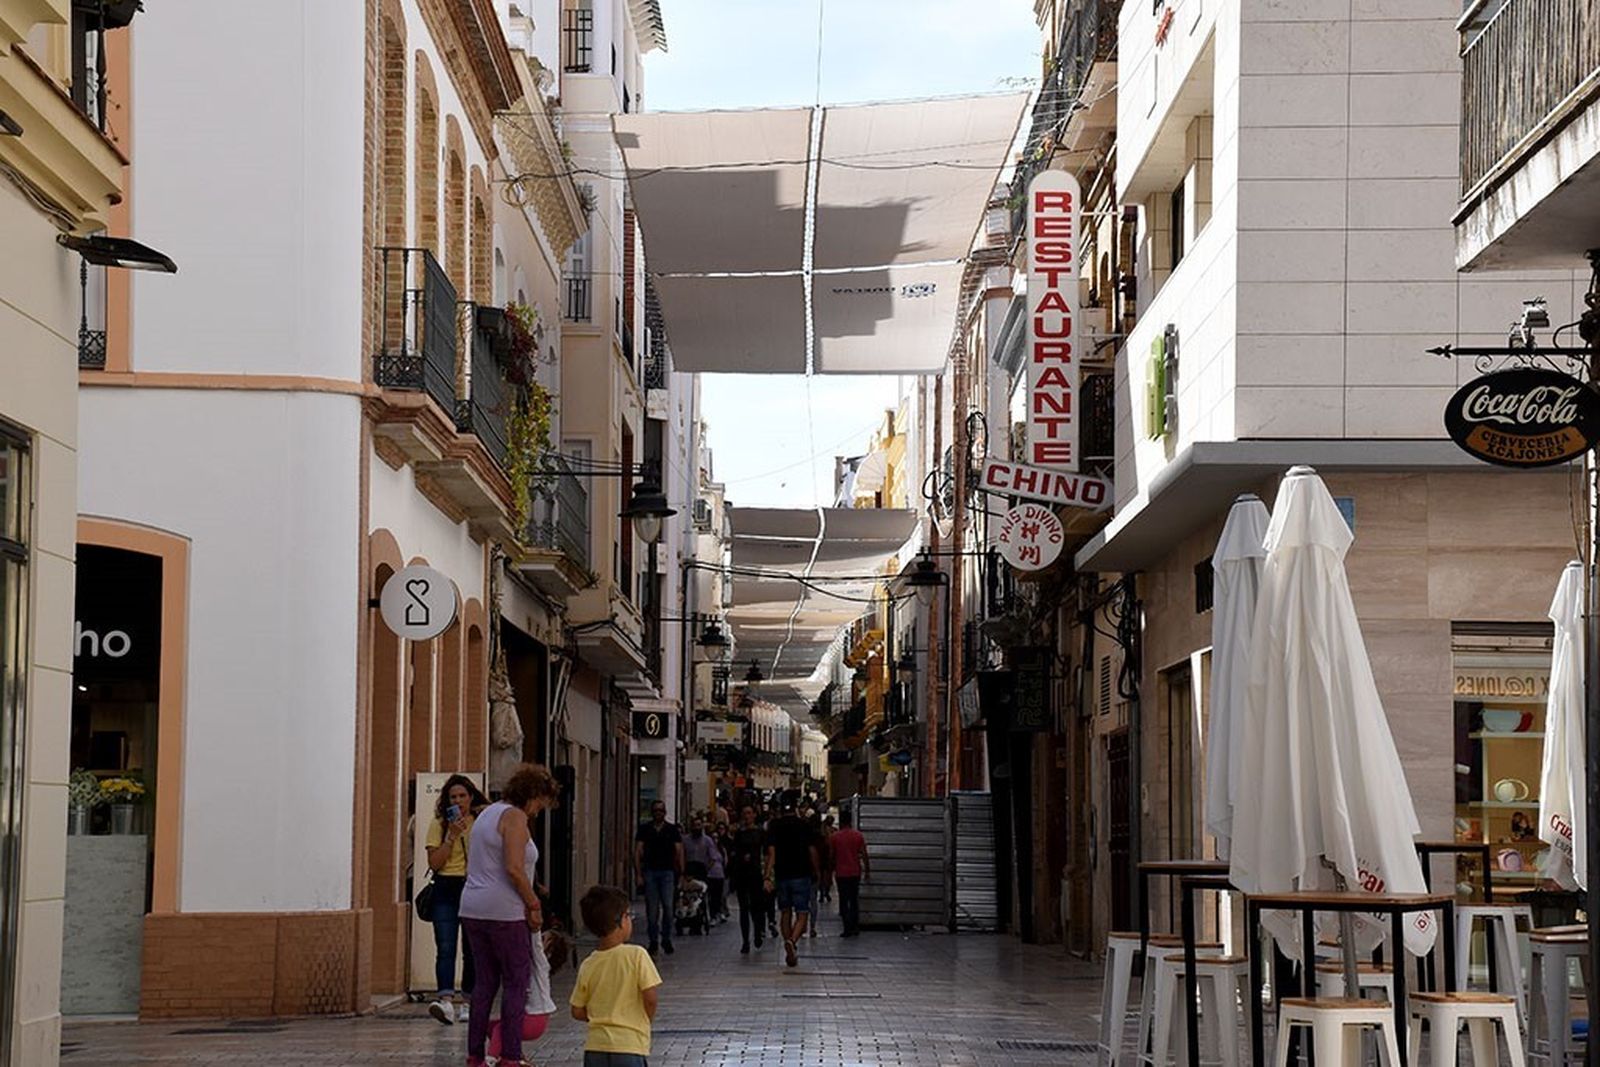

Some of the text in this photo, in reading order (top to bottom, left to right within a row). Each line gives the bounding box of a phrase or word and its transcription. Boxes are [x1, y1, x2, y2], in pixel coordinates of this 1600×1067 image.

[1034, 191, 1072, 463] RESTAURANTE
[1462, 384, 1582, 425] Coca-Cola
[1481, 430, 1570, 449] CERVECERIA
[986, 463, 1106, 505] CHINO
[1024, 506, 1062, 544] DIVINO
